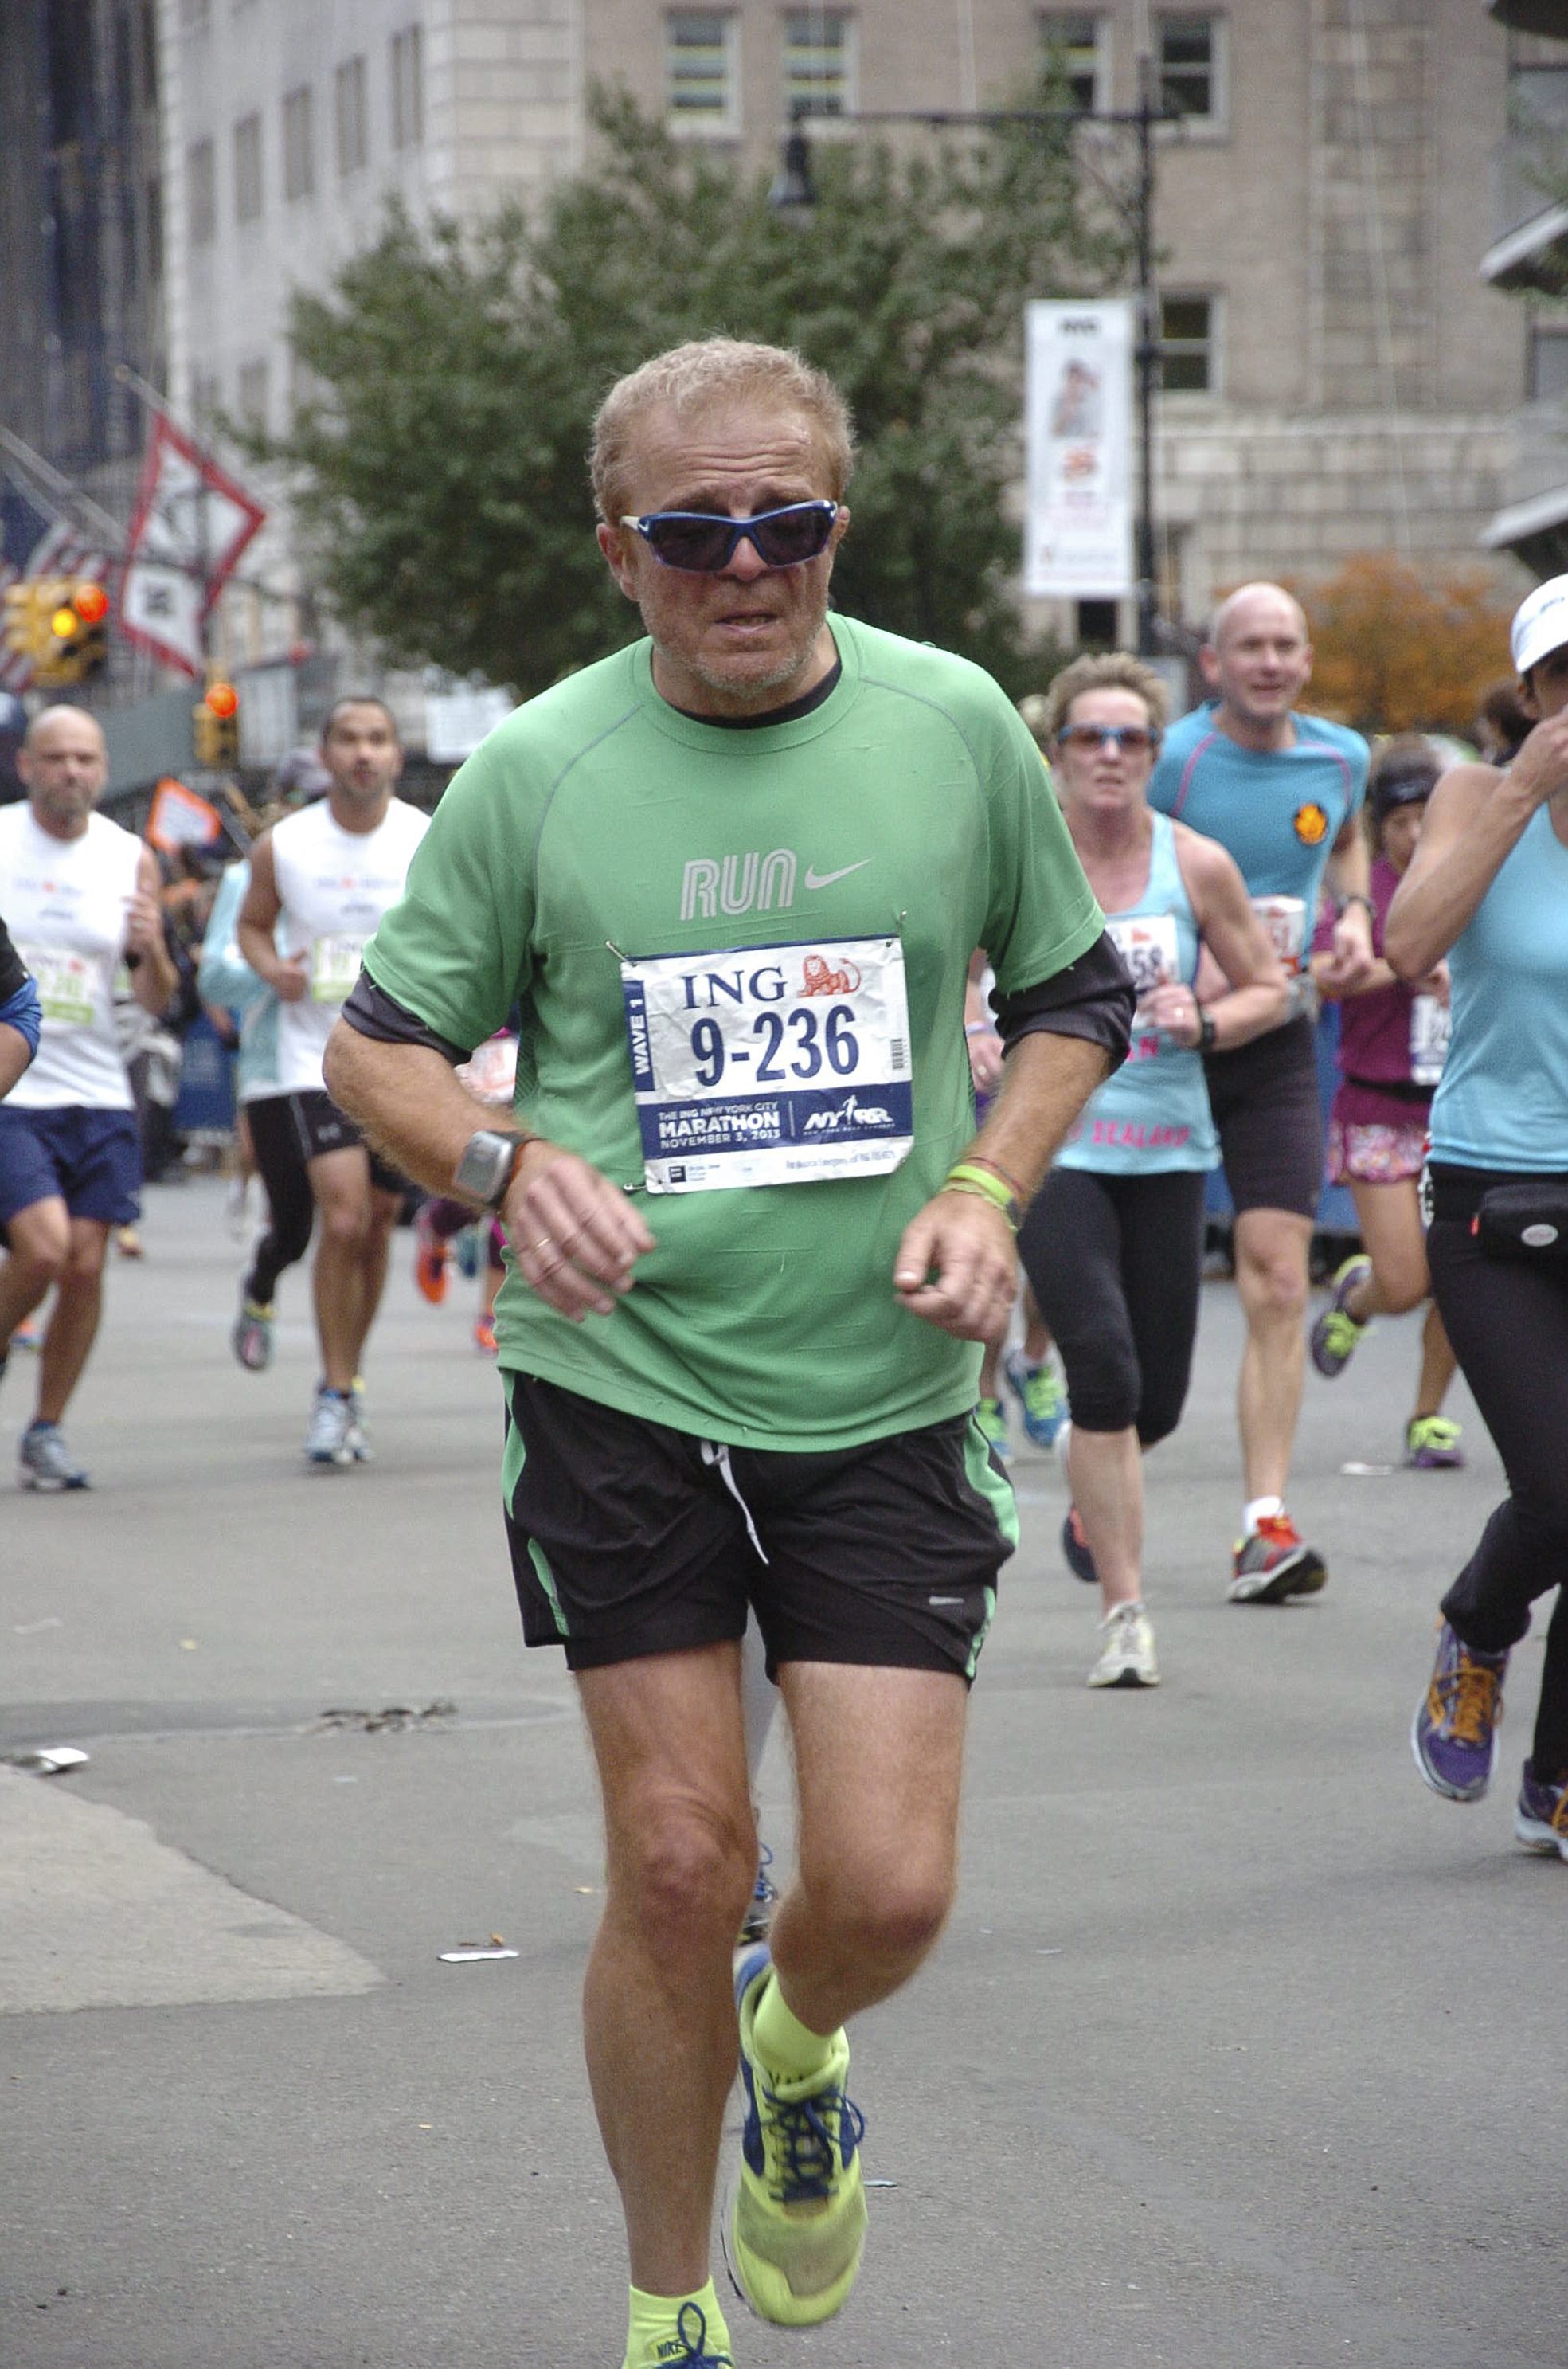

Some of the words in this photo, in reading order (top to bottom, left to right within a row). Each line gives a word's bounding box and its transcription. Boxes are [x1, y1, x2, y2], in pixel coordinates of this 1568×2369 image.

[679, 848, 796, 921] RUN
[629, 998, 643, 1008] 1
[682, 966, 788, 1010] ING
[629, 1014, 650, 1075] WAVE
[690, 1004, 860, 1087] 9-236
[659, 1110, 677, 1121] THE
[678, 1108, 699, 1119] ING
[700, 1106, 725, 1116] NEW
[725, 1104, 753, 1114] YORK
[754, 1101, 778, 1112] CITY
[659, 1111, 780, 1138] MARATHON
[660, 1133, 731, 1149] NOVEMBER
[735, 1131, 747, 1143] 3,
[751, 1128, 781, 1141] 2013
